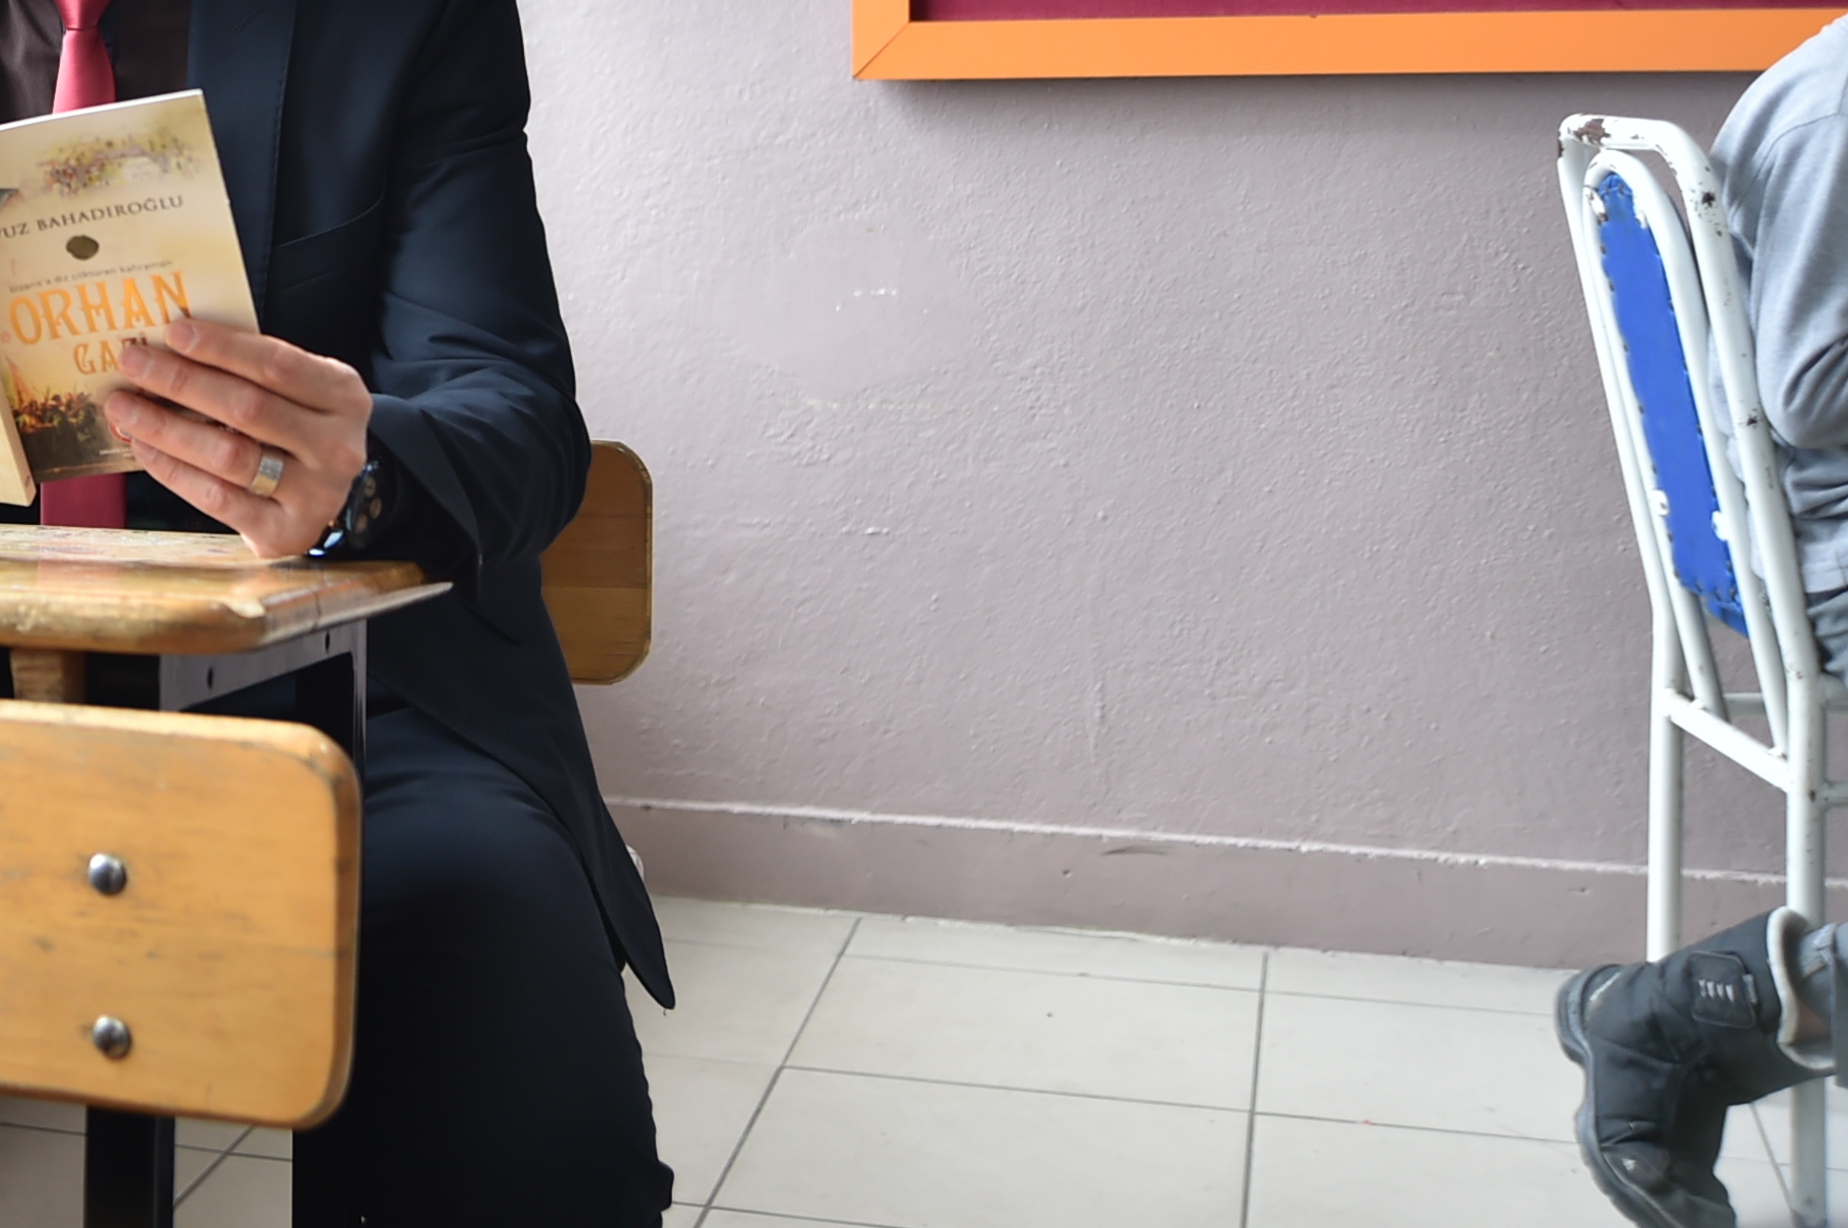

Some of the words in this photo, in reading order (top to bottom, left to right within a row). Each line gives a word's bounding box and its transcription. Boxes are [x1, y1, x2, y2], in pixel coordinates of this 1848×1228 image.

[37, 195, 184, 232] BAHADIROĞLU
[9, 269, 193, 345] ORHAN
[73, 331, 149, 376] GA
